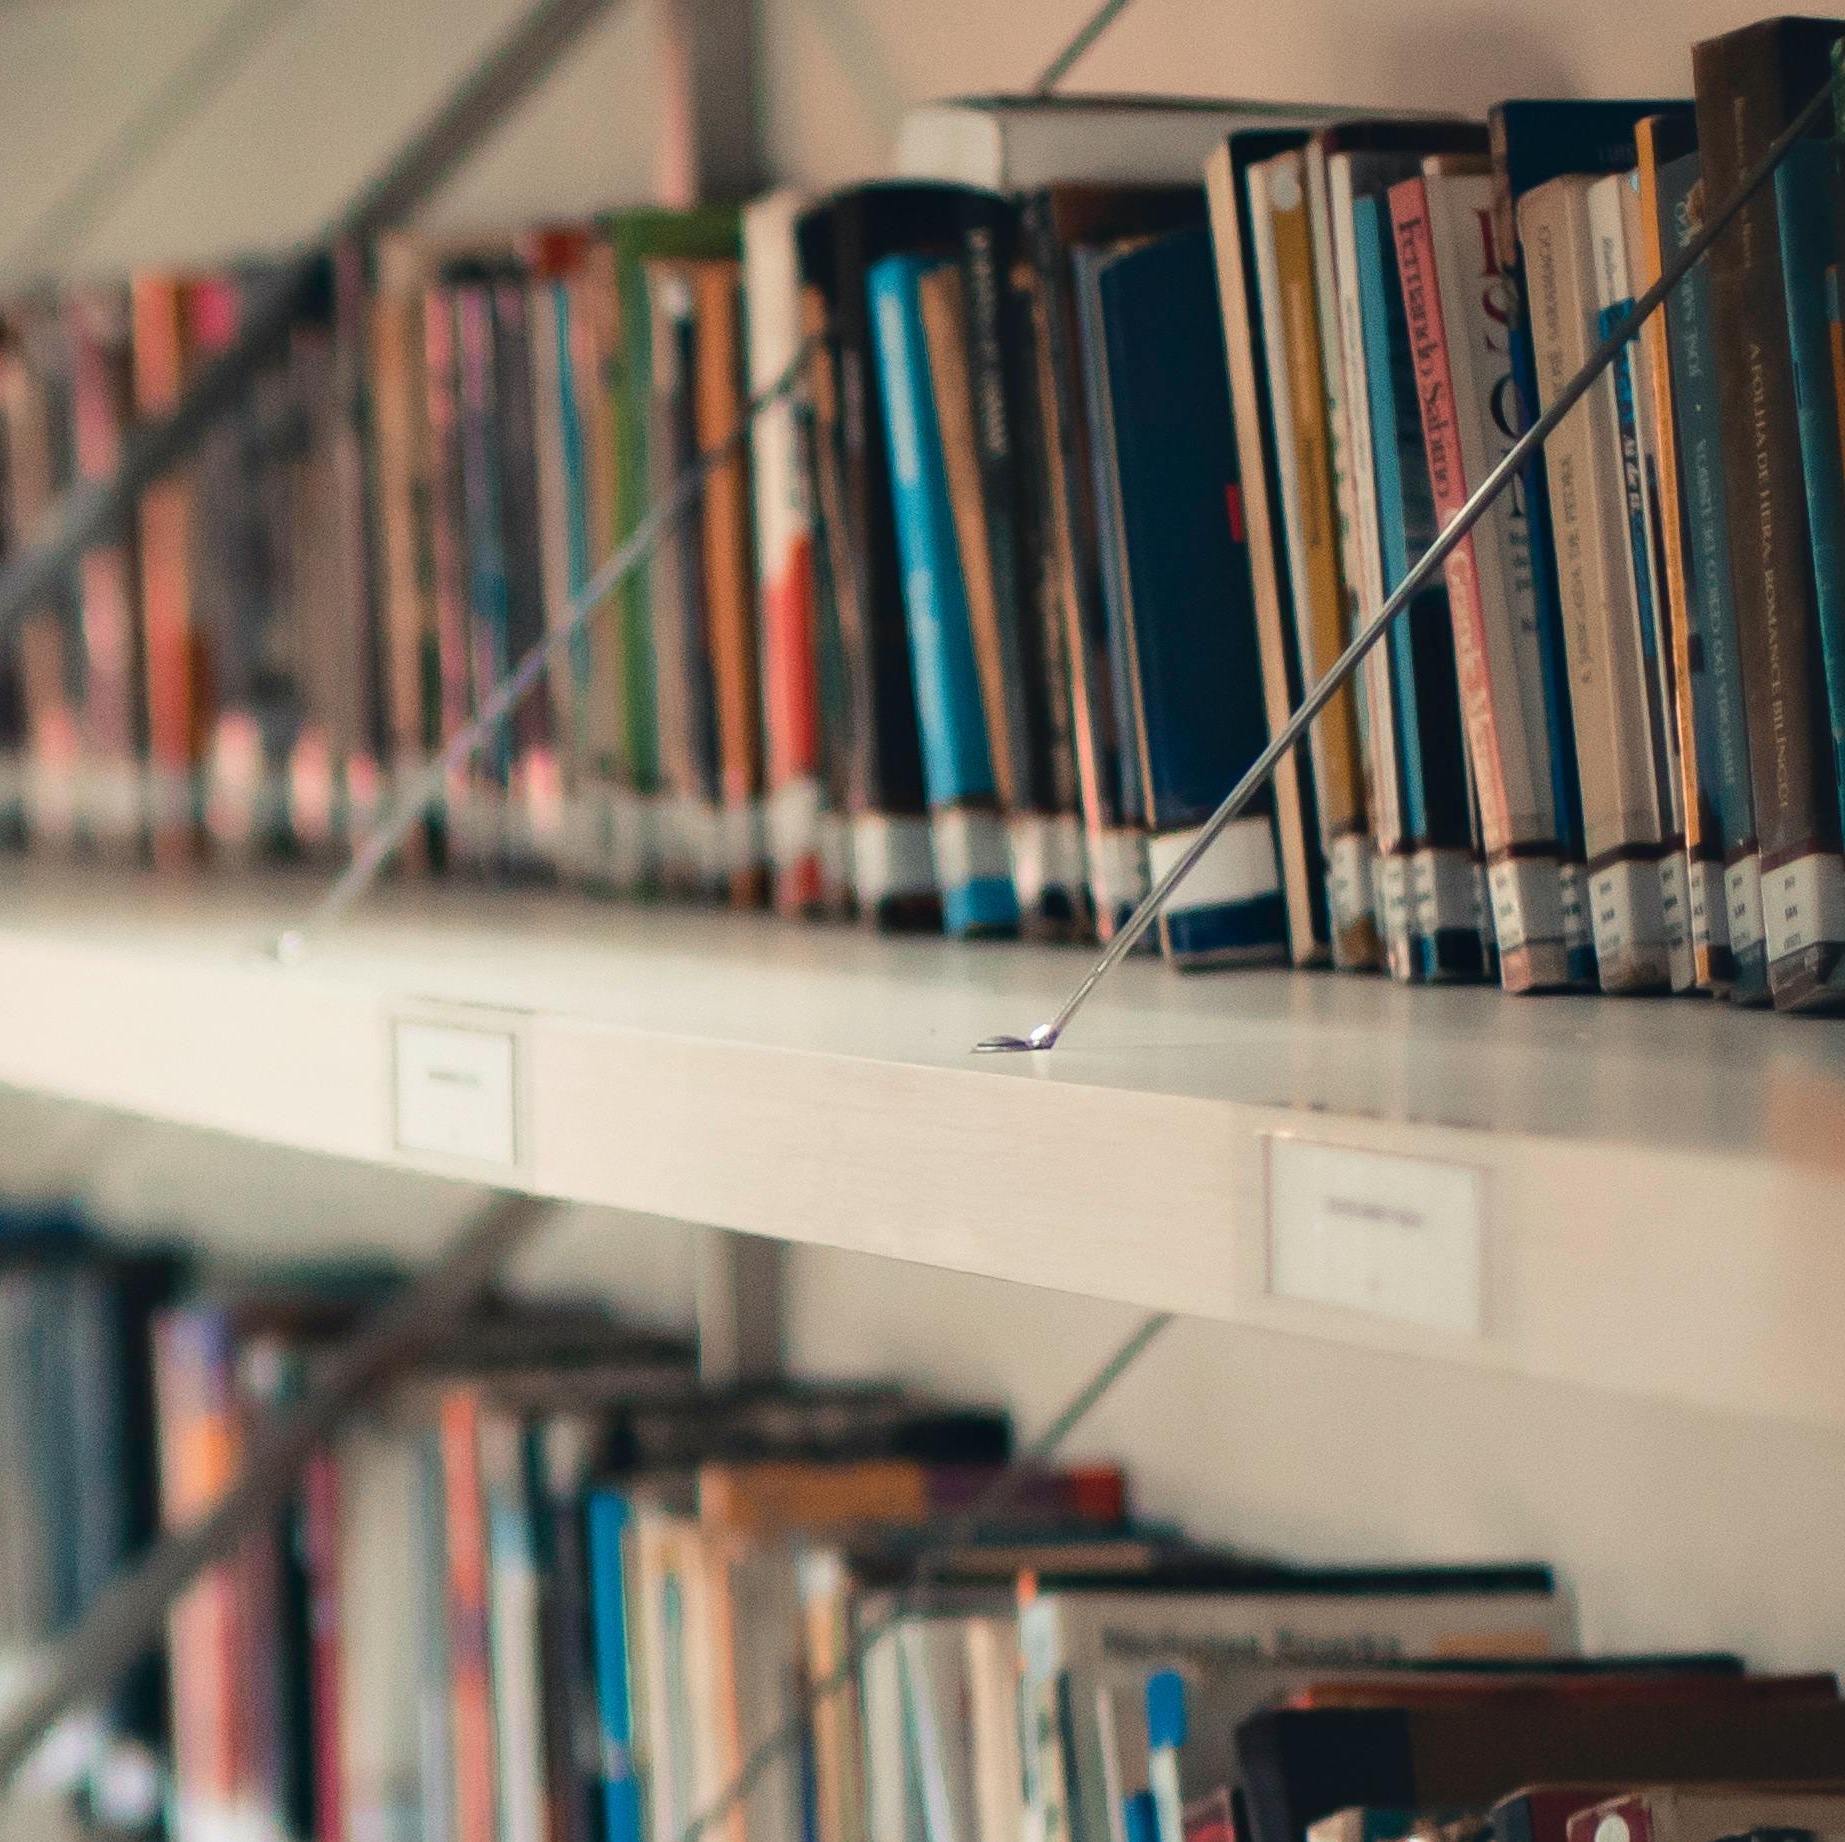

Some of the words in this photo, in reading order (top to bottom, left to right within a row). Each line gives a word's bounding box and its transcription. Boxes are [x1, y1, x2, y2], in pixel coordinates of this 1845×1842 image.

[1398, 215, 1439, 372] Fernando
[1419, 379, 1453, 500] Sabino
[1747, 364, 1768, 447] FOLHA
[1752, 452, 1769, 484] DE
[1758, 568, 1784, 694] ROMANCE
